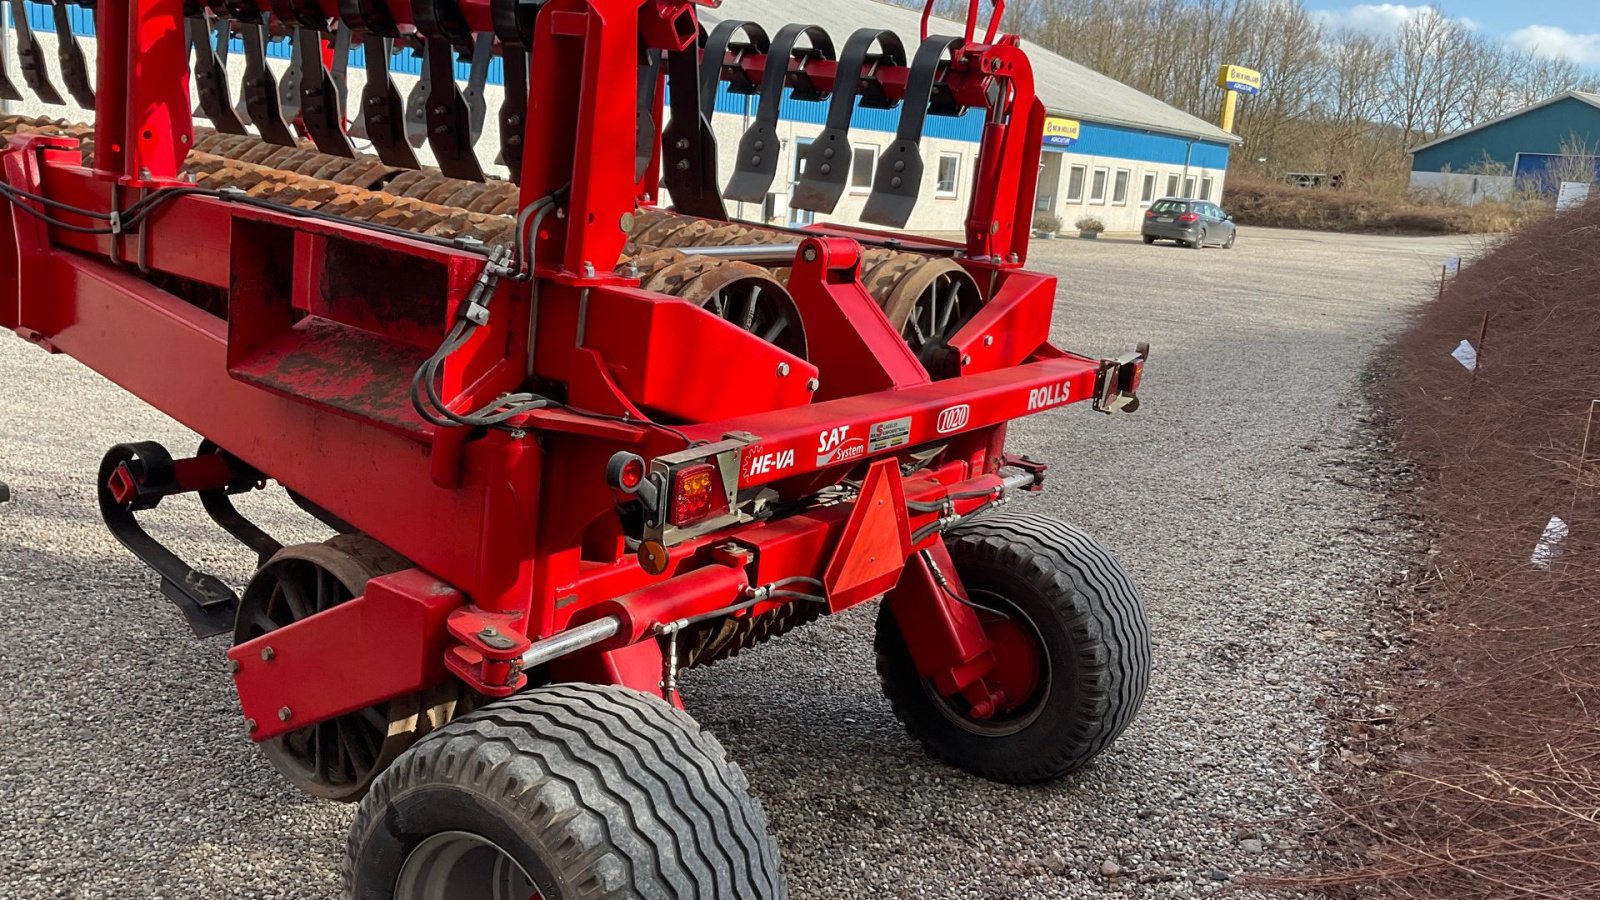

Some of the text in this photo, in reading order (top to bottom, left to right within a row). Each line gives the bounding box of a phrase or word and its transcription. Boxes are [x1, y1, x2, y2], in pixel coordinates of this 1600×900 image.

[1061, 126, 1077, 134] HOLLAND
[1027, 381, 1071, 410] ROLLS
[941, 406, 967, 431] 1020
[818, 425, 850, 453] SAT
[749, 449, 795, 477] HE-VA
[836, 444, 864, 461] System
